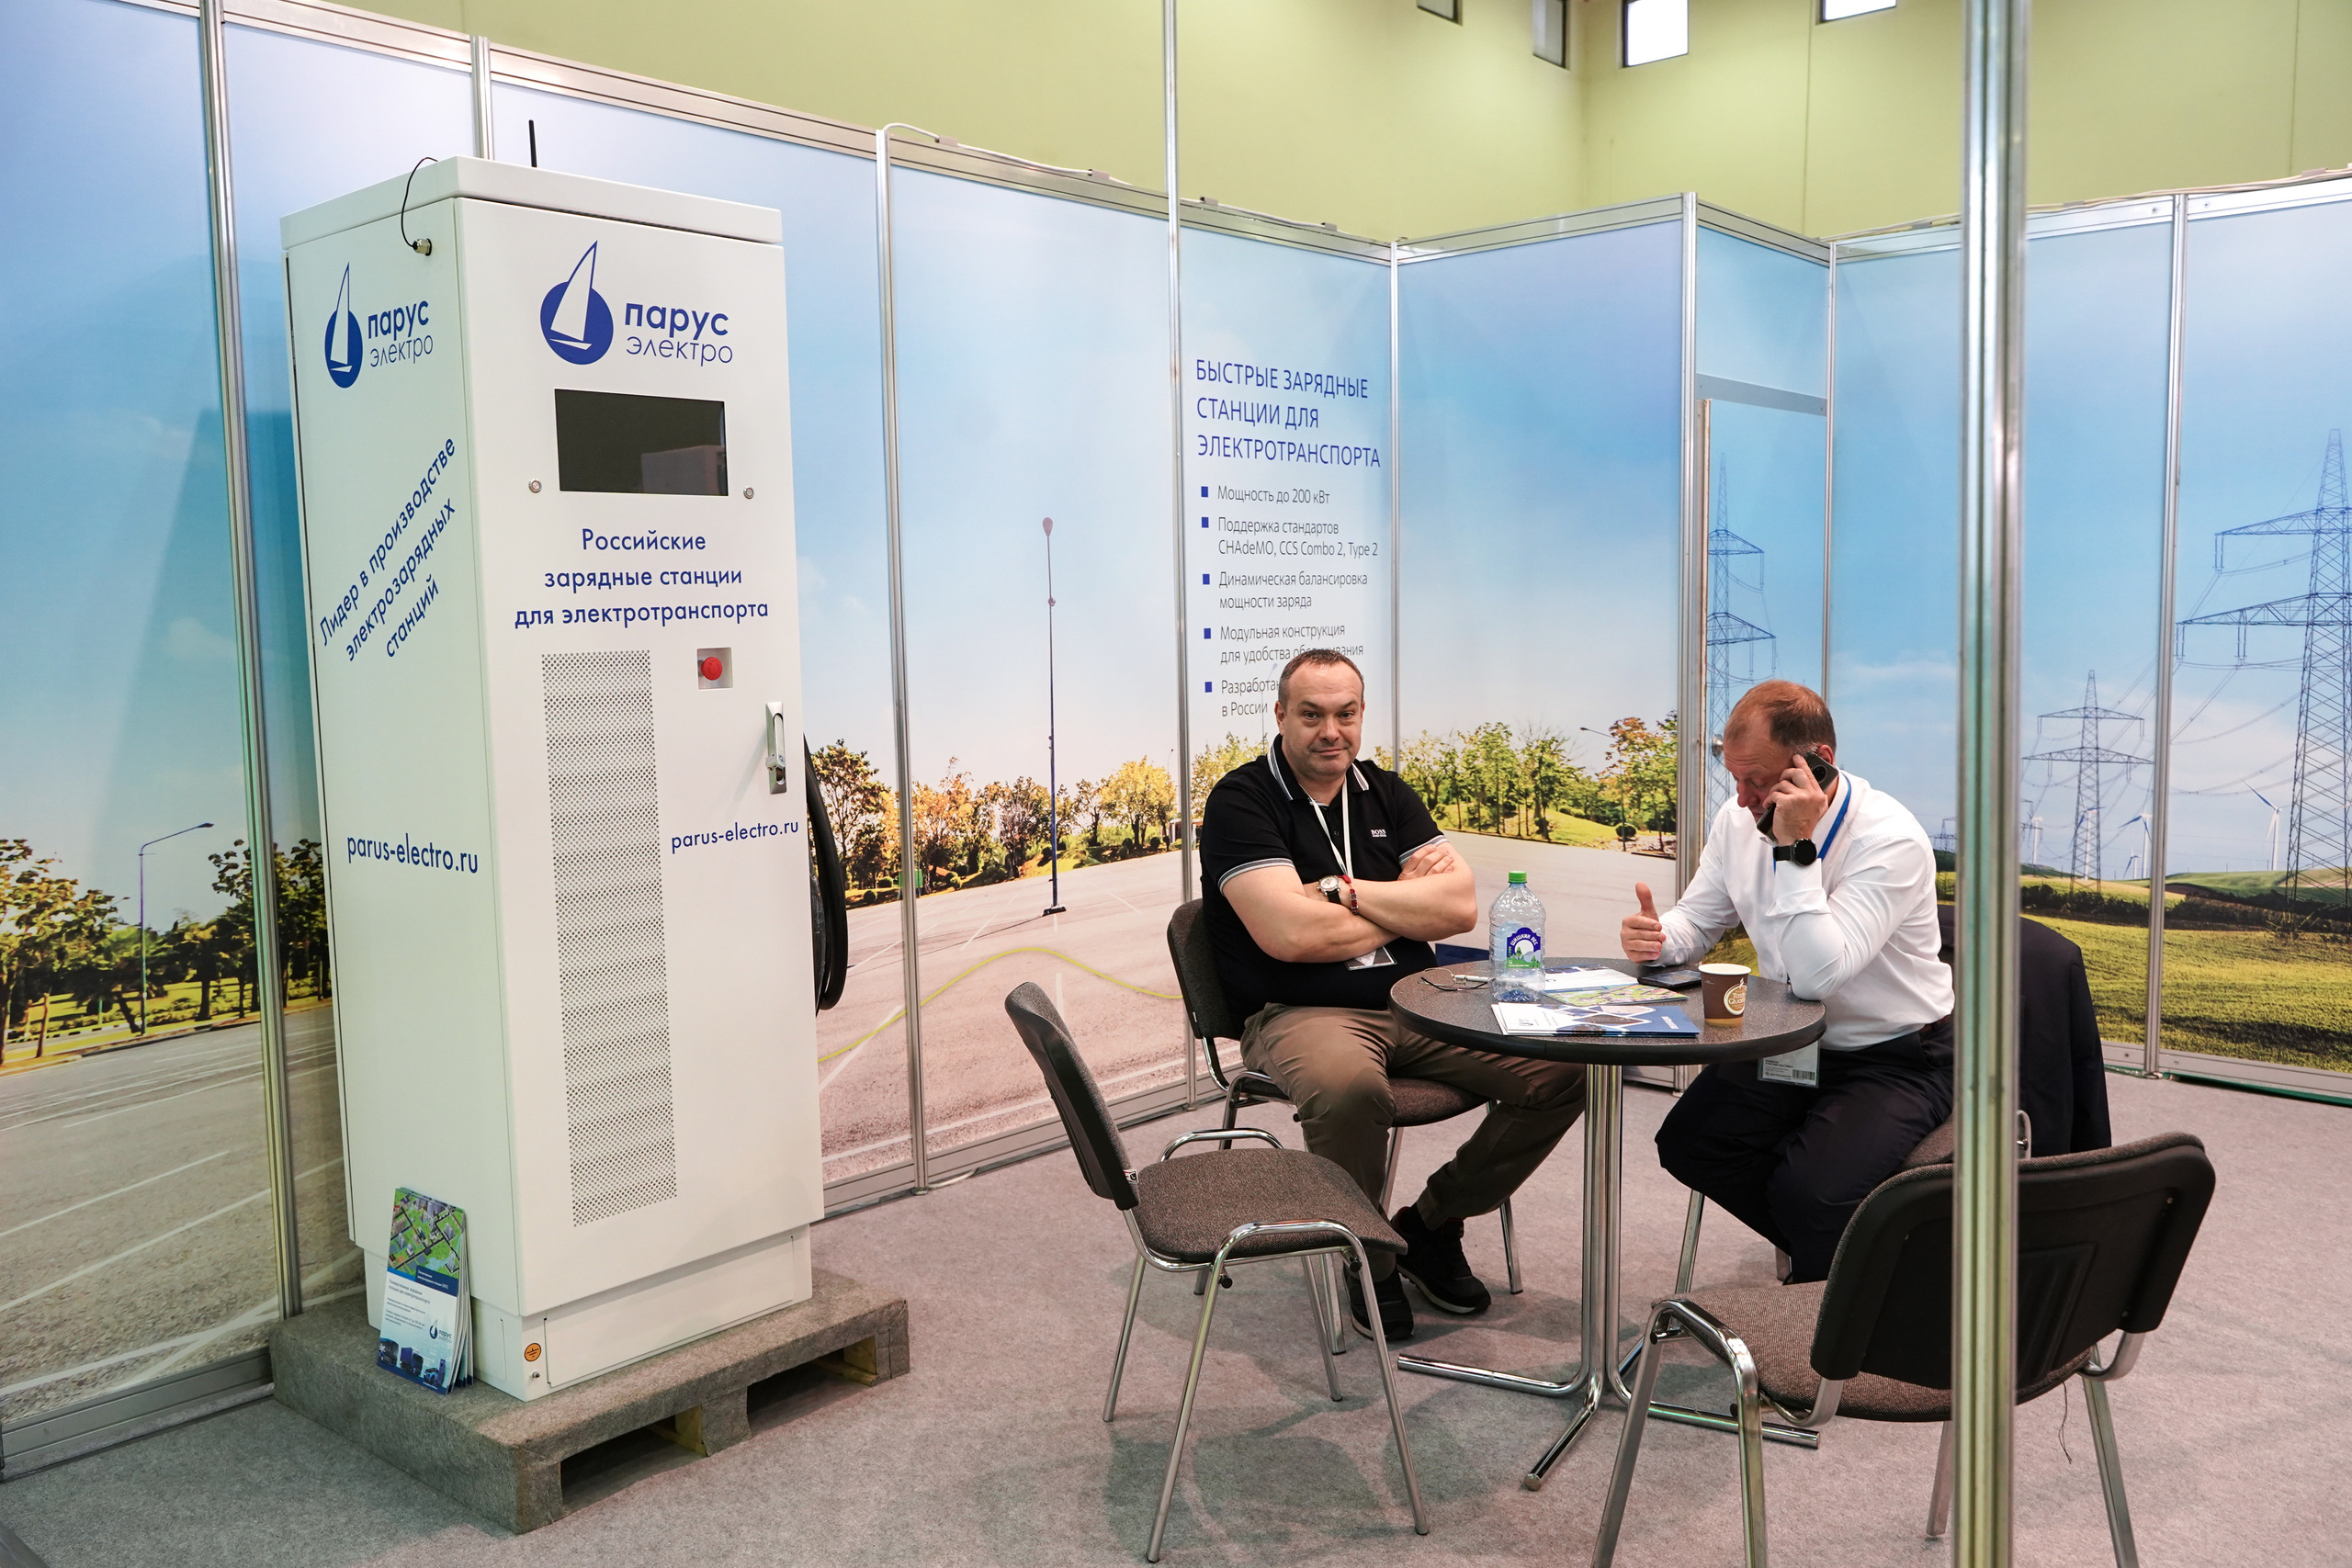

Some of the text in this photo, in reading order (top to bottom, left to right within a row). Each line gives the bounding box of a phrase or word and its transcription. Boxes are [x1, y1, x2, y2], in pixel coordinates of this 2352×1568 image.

[368, 300, 429, 341] парус
[625, 303, 729, 340] парус
[370, 335, 433, 367] электро
[627, 336, 733, 367] электро
[1197, 359, 1368, 399] БЫСТРЫЕ ЗАРЯДНЫЕ
[1197, 397, 1318, 430] СТАНЦИИ ДЛЯ
[1198, 434, 1380, 468] ЭЛЕКТРОТРАНСПОРТА
[1218, 485, 1330, 504] Мощность до 200 кВт
[320, 438, 455, 646] Лидер в производстве
[582, 528, 707, 550] Российские
[1218, 517, 1339, 536] Поддержка стандартов
[1219, 539, 1378, 558] CHAdeMO, CCS Combo 2, Type 2
[346, 498, 456, 661] электрозарядных
[544, 570, 742, 593] зарядные станции
[1219, 570, 1368, 588] Динамическая балансировка
[386, 574, 439, 658] станций
[514, 603, 768, 629] для электротранспорта
[1219, 596, 1312, 611] мощности заряда
[1220, 625, 1345, 643] Модульная конструкция
[1220, 644, 1363, 665] для удобства обвания
[1222, 702, 1268, 716] в России
[671, 819, 799, 854] parus-electro.ru
[347, 833, 479, 874] parus-electro.ru
